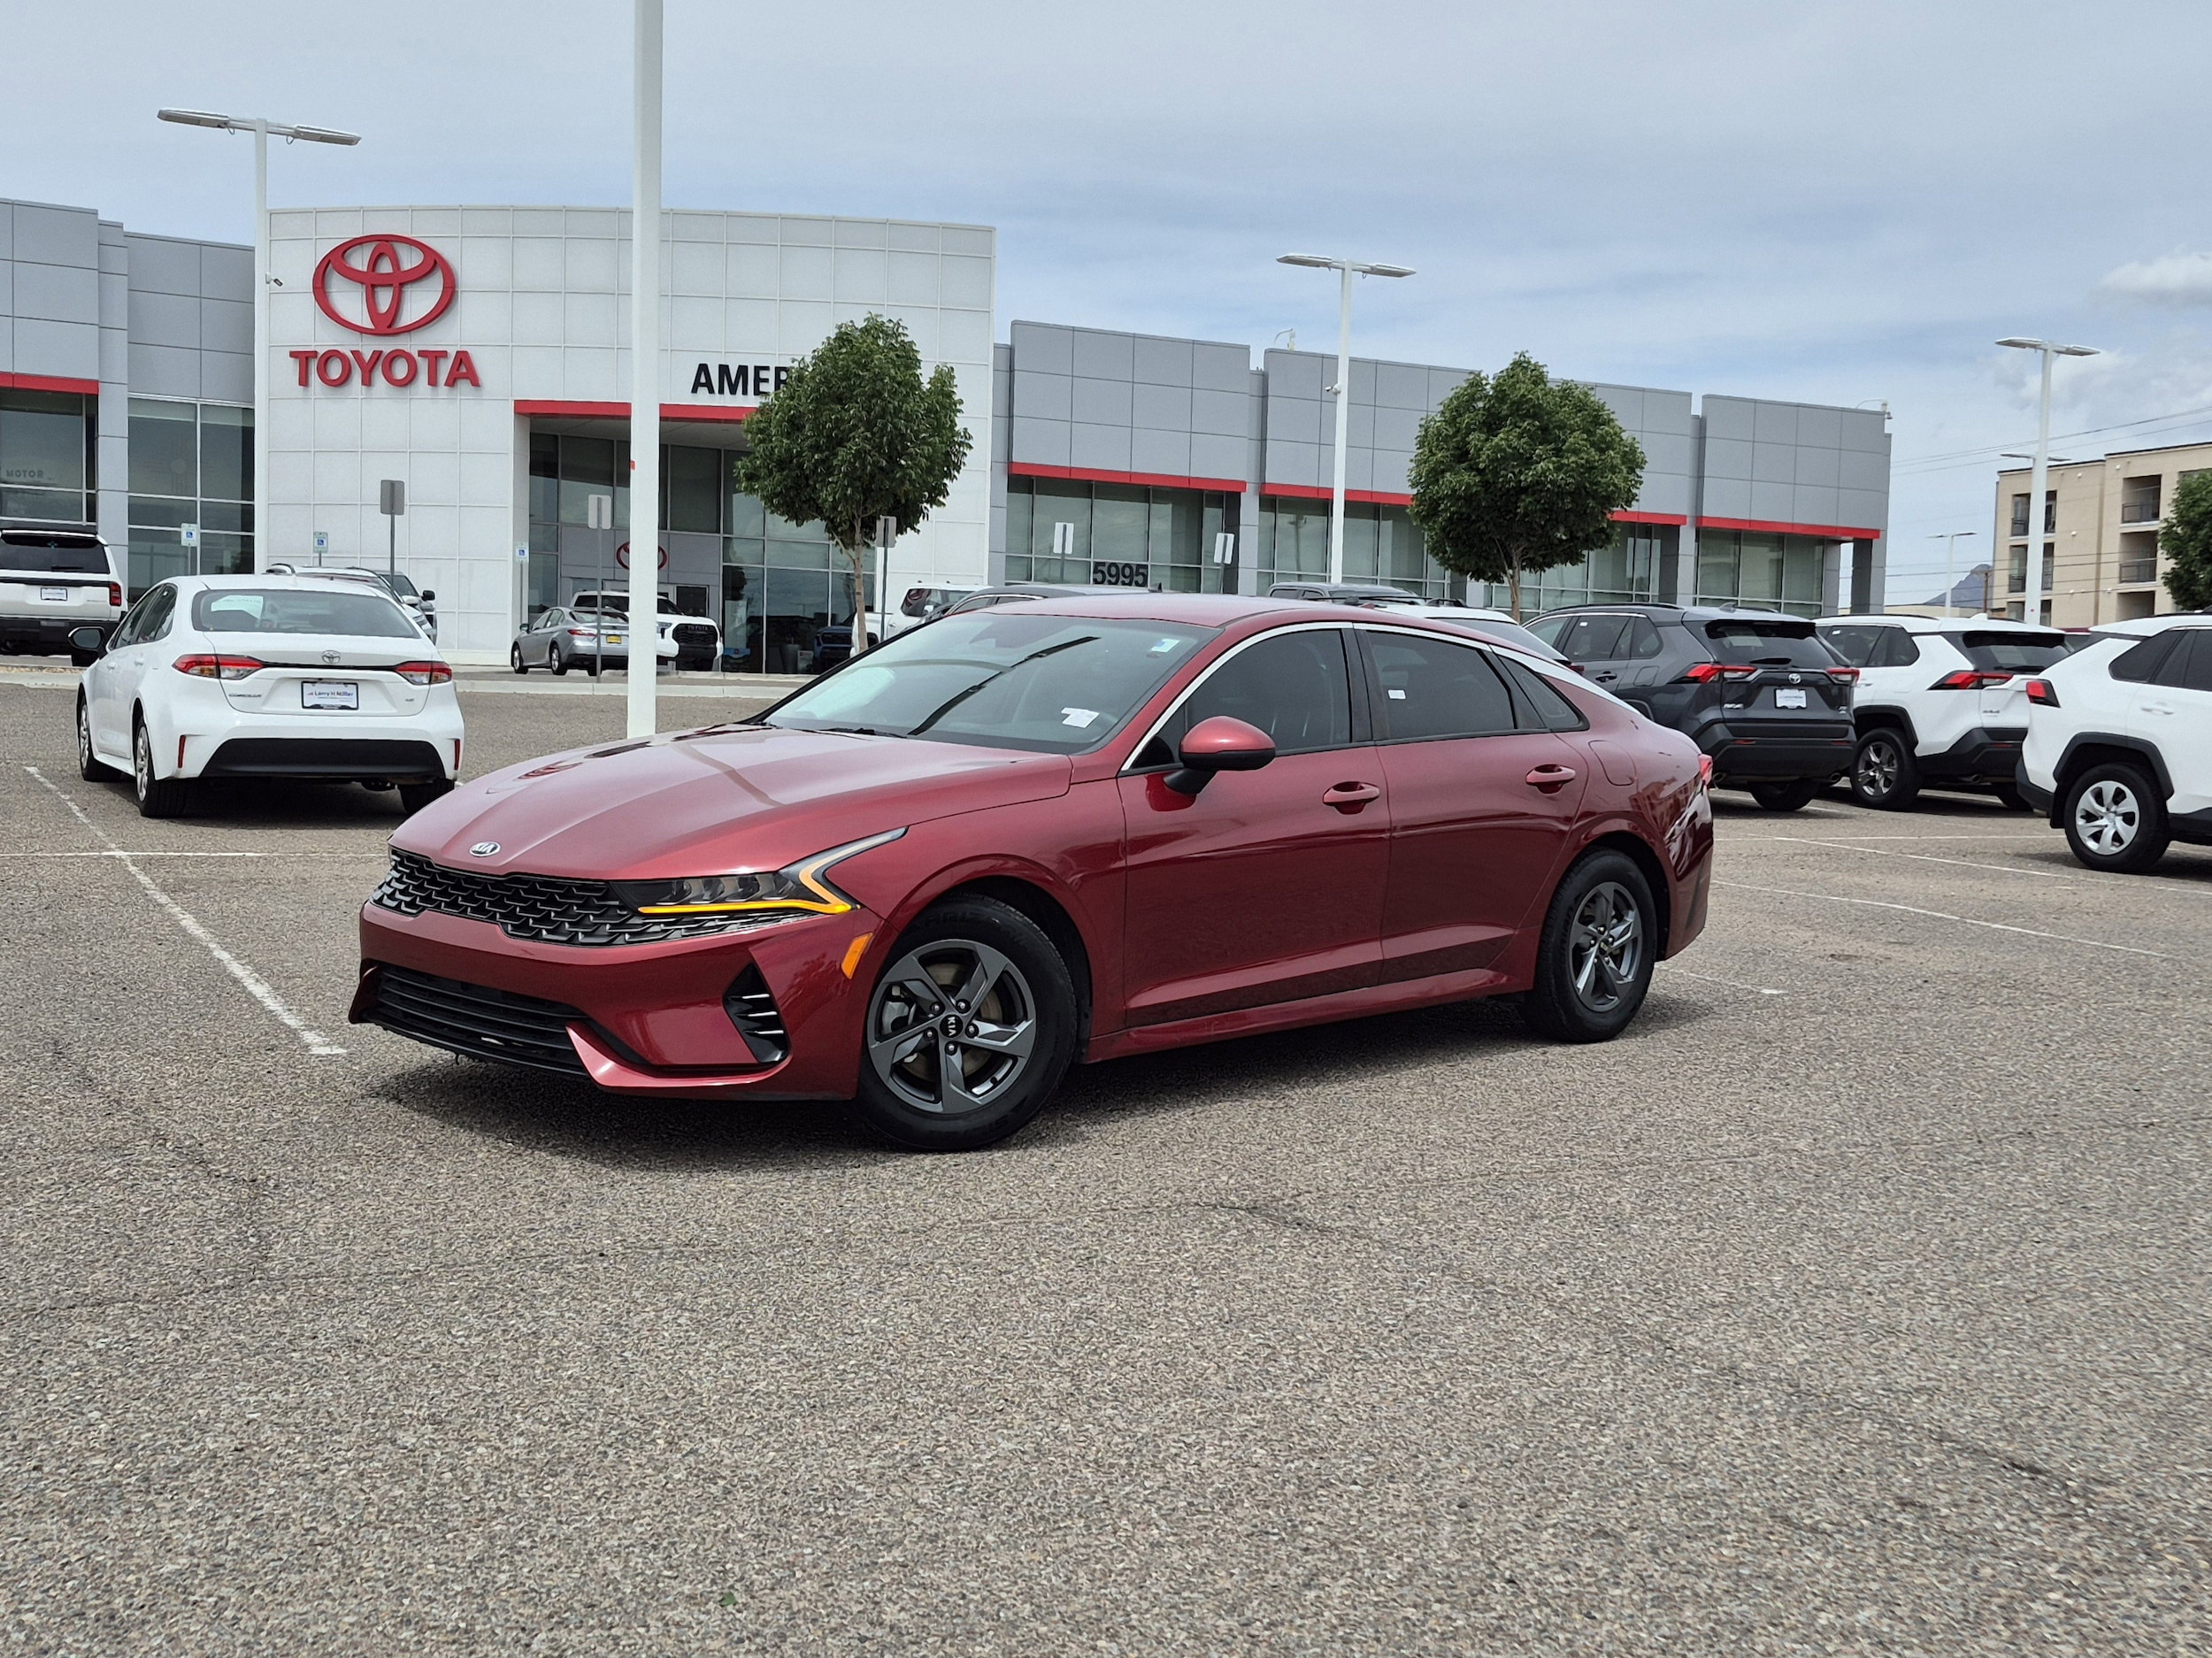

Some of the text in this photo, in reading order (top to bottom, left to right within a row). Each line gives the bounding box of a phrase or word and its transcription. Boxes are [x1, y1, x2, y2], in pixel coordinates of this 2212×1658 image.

[289, 349, 481, 388] TOYOTA
[1093, 561, 1148, 587] 5995
[472, 842, 495, 854] KIA
[947, 1016, 956, 1036] KIA
